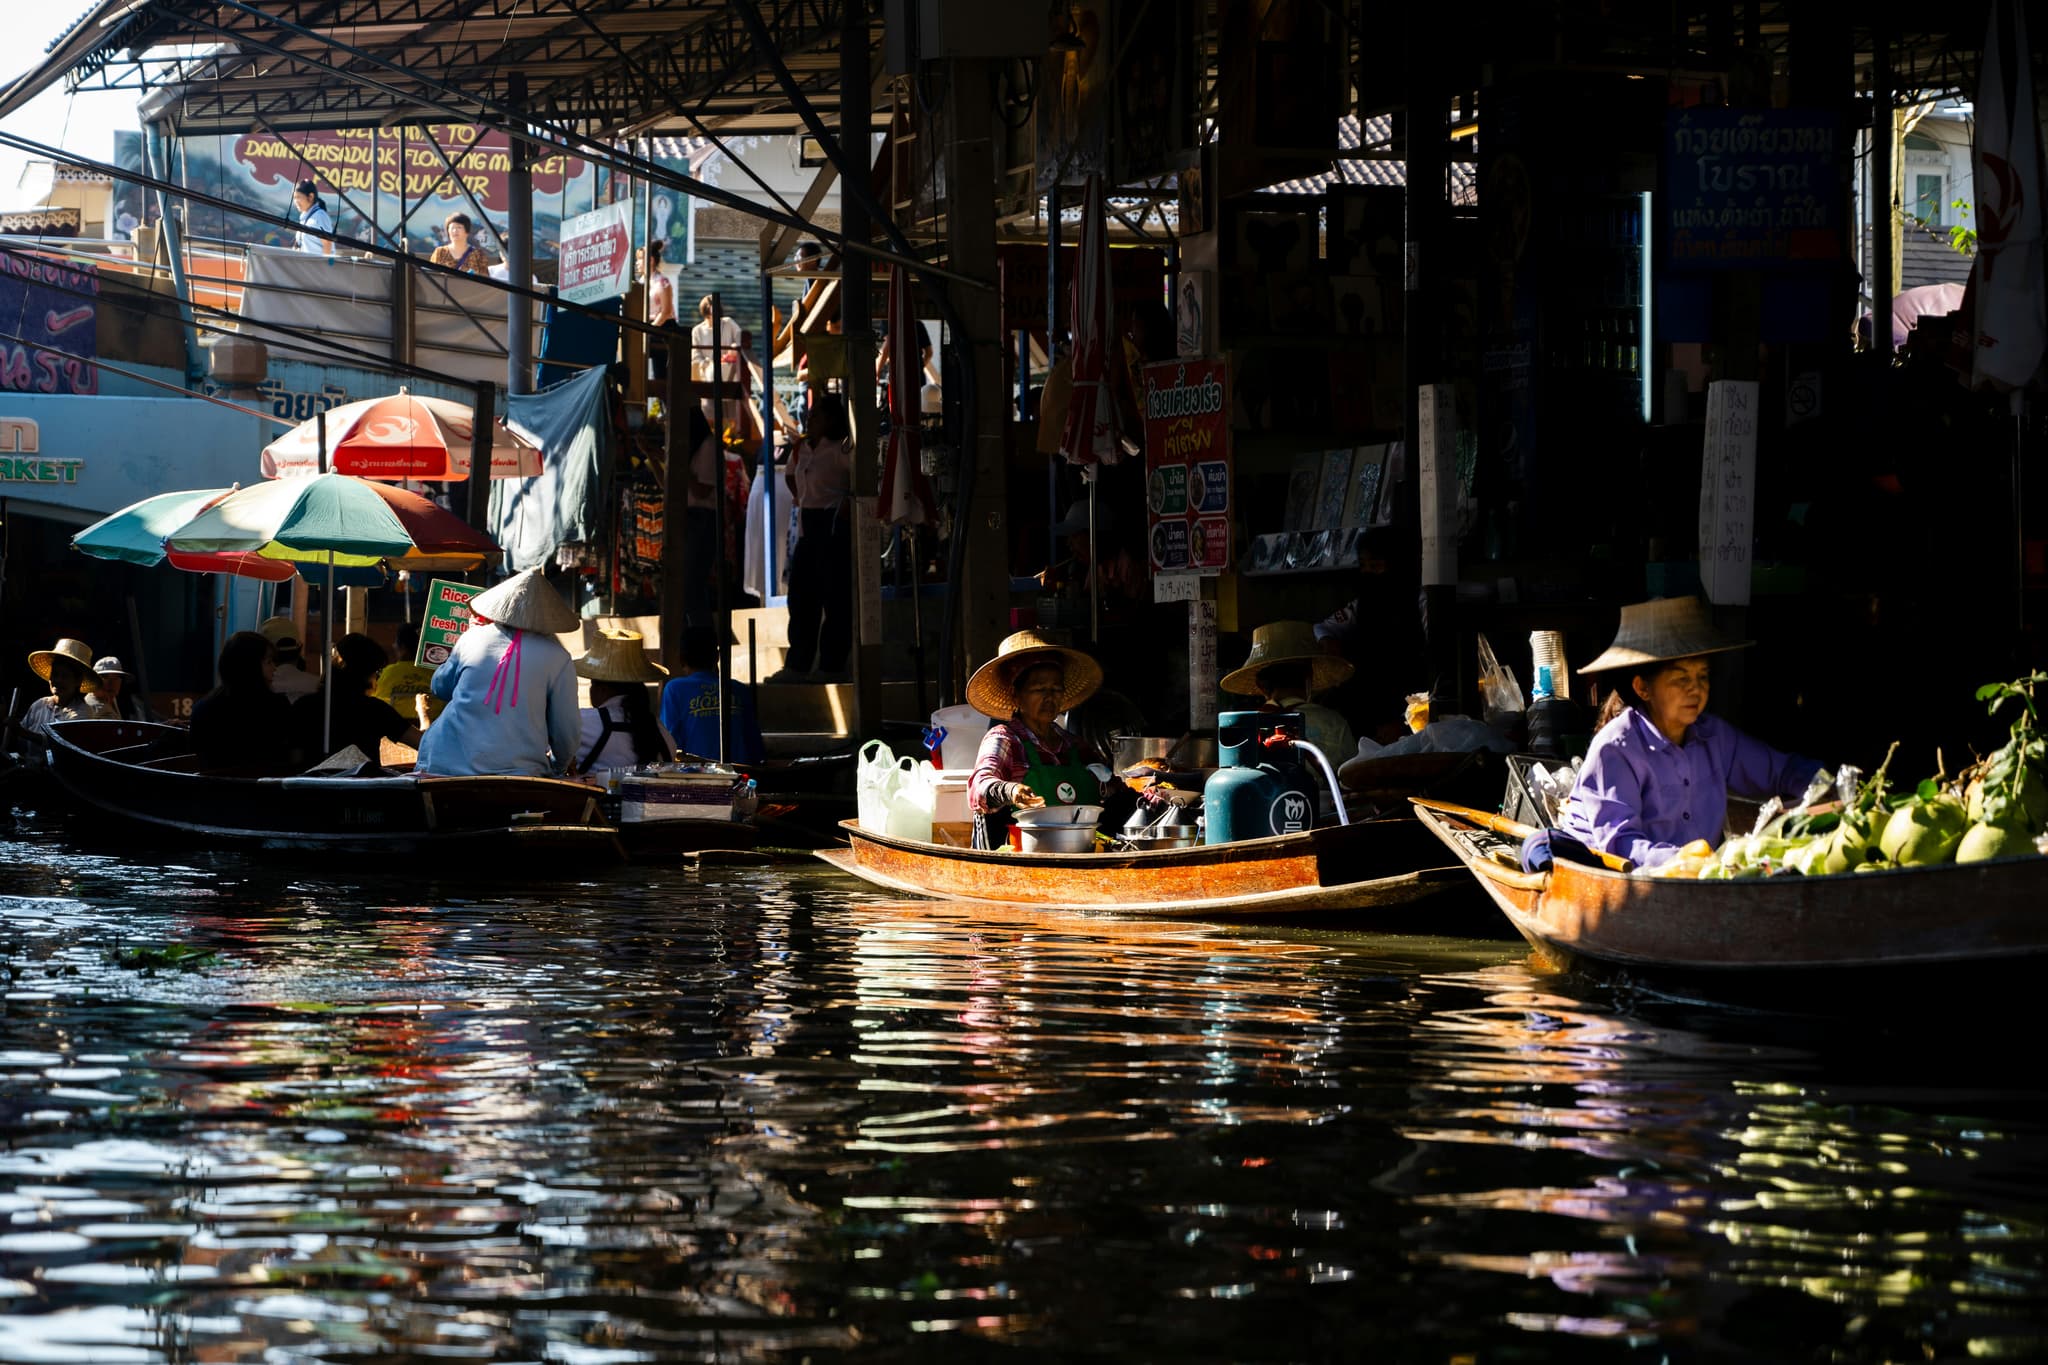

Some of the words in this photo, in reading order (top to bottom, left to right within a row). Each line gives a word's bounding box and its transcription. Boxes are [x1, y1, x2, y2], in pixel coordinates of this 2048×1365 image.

[1696, 153, 1810, 193] โบราณ
[582, 259, 611, 281] SERVICE
[441, 587, 469, 603] Rice
[431, 616, 457, 631] fresh
[171, 698, 193, 717] 18
